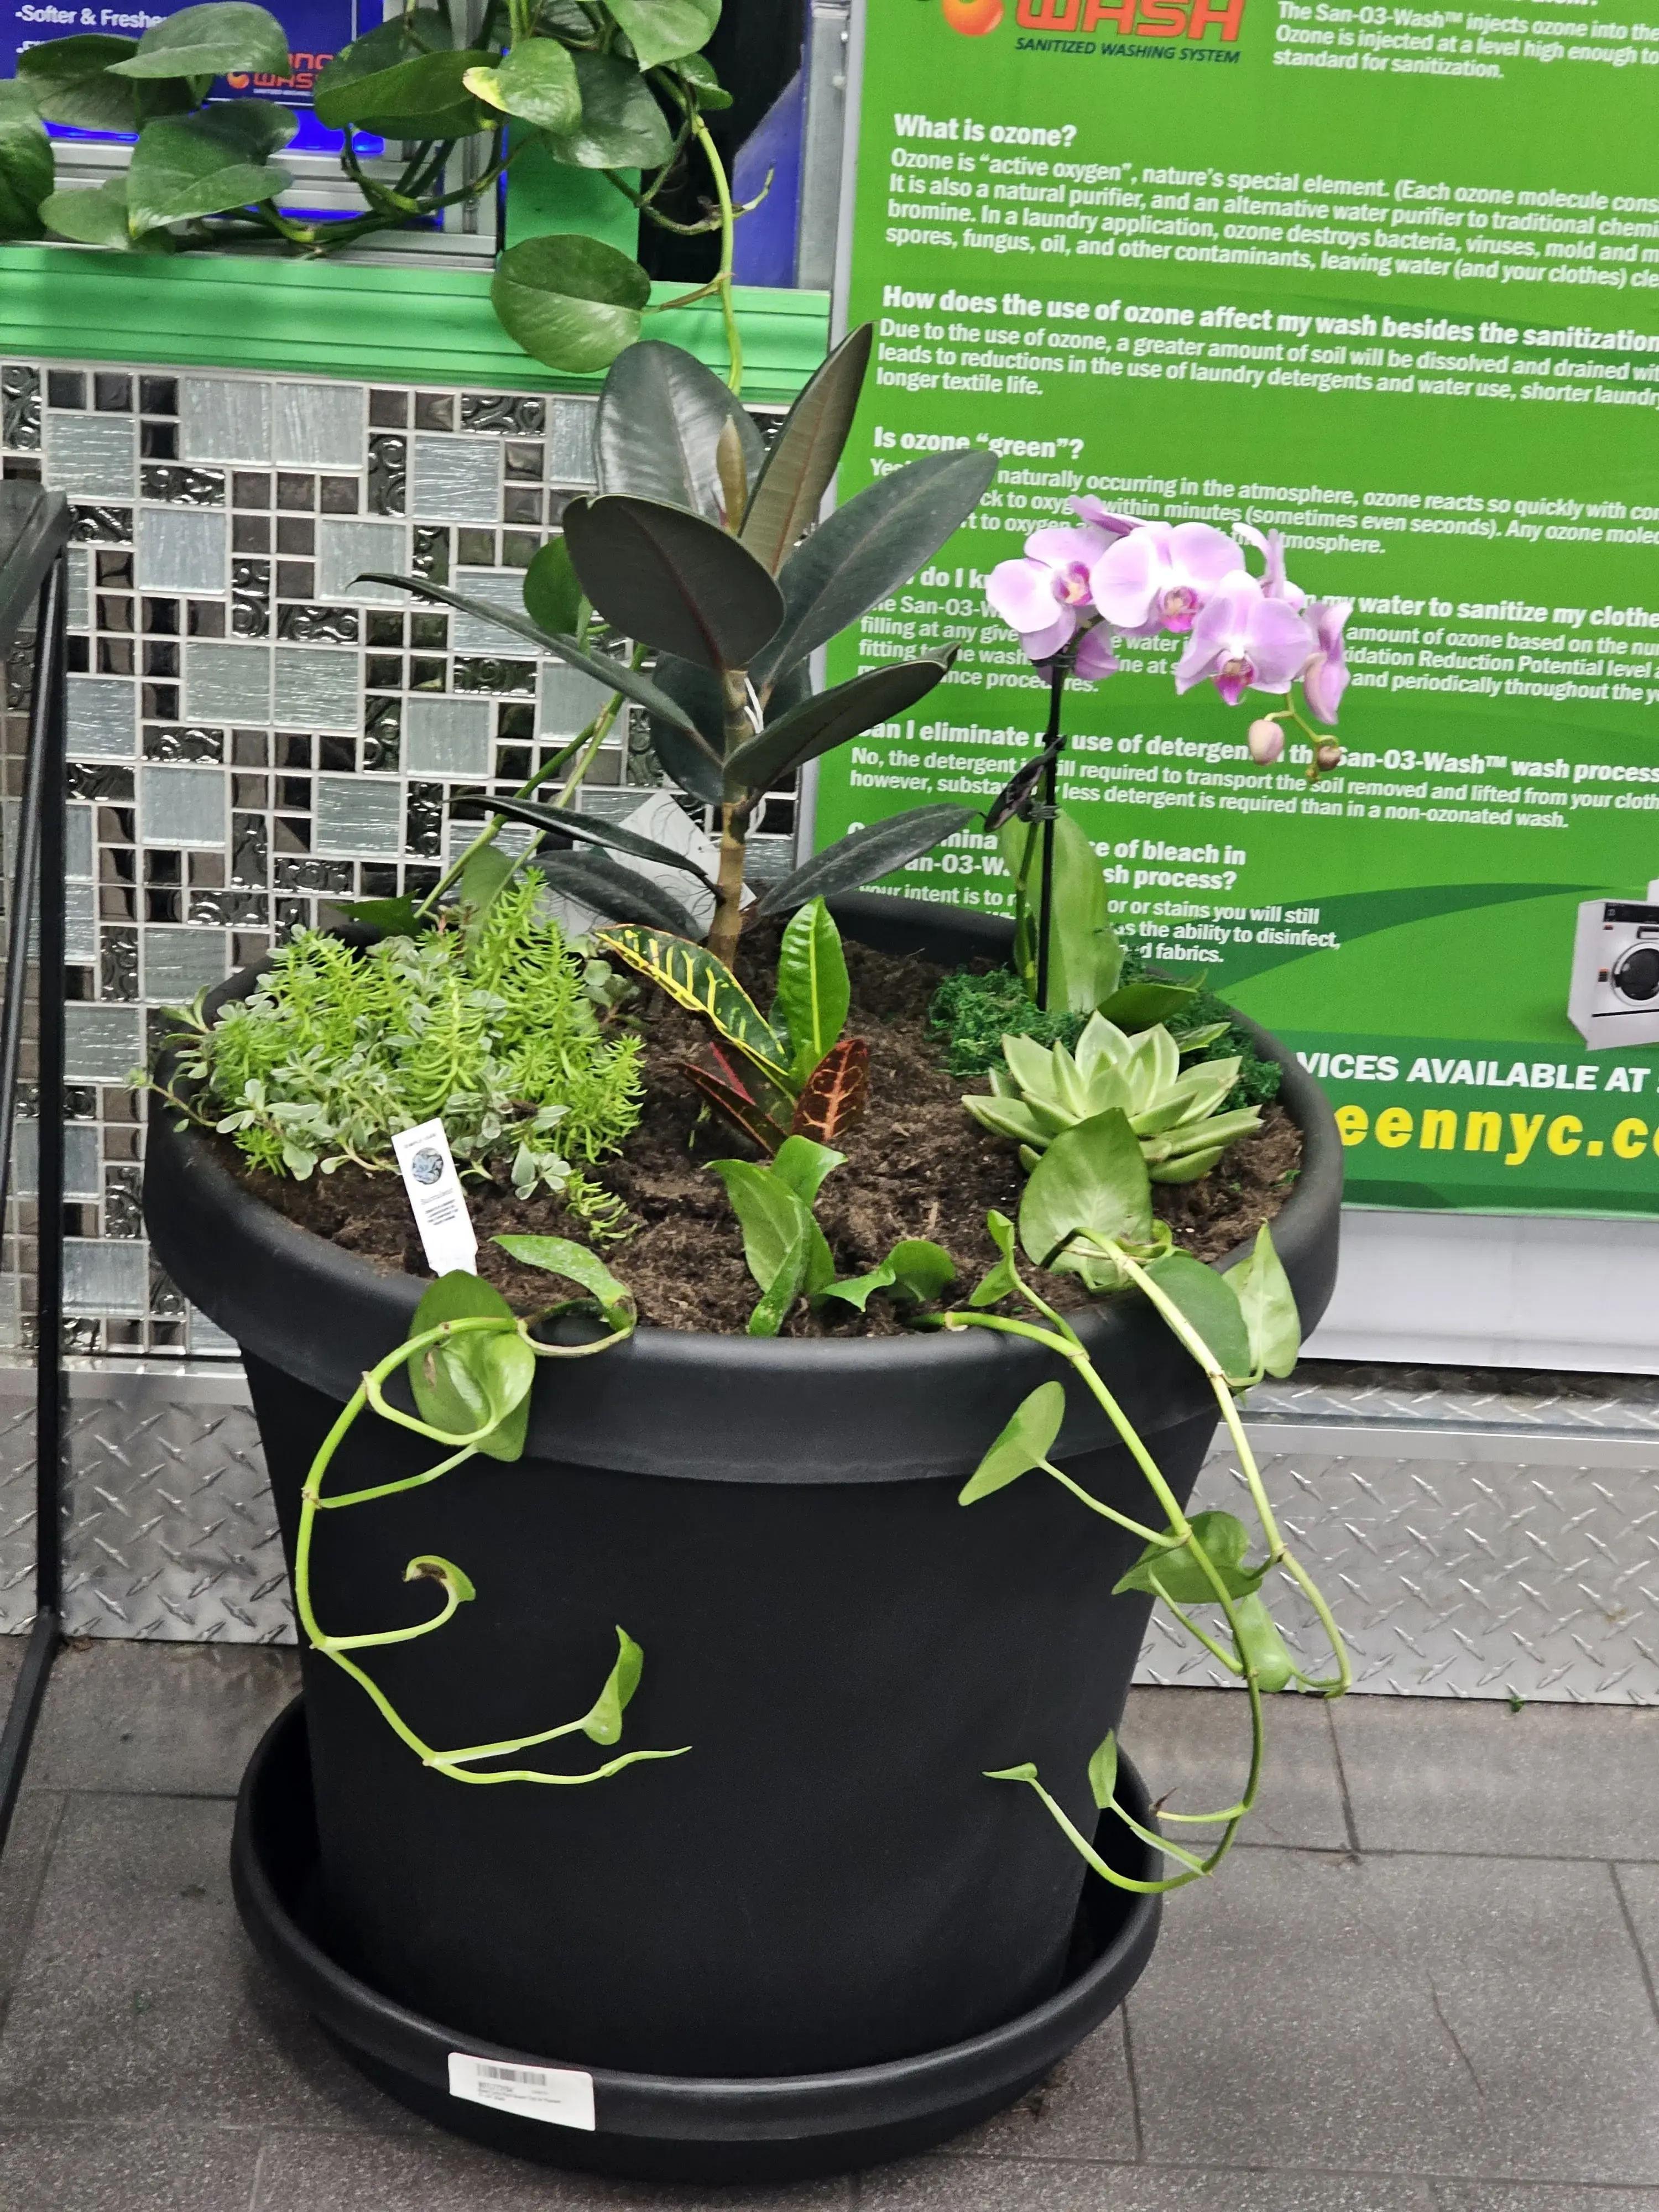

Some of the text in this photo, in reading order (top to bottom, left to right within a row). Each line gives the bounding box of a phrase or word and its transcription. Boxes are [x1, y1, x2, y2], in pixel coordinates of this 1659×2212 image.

[80, 8, 97, 25] &
[1015, 0, 1245, 42] WASH
[1277, 0, 1313, 22] The
[1465, 12, 1530, 36] injects
[1531, 19, 1589, 38] ozone
[1590, 19, 1629, 40] into
[1015, 37, 1240, 64] SANITIZED WASHING SYSTEM
[1275, 23, 1335, 46] Ozone
[1338, 27, 1355, 47] is
[1358, 28, 1434, 53] injected
[1437, 35, 1458, 53] at
[1459, 38, 1473, 55] a
[1476, 36, 1521, 57] level
[1524, 39, 1565, 63] high
[1567, 45, 1638, 68] enough
[1274, 48, 1503, 80] standard for sanitization.
[893, 112, 1077, 148] What is ozone?
[890, 147, 954, 171] Ozone
[957, 152, 976, 173] is
[1226, 171, 1300, 194] special
[1302, 174, 1390, 198] element.
[1393, 178, 1452, 202] (Each
[1453, 186, 1515, 205] ozone
[1516, 187, 1610, 211] molecule
[885, 227, 1628, 290] spores, fungus, oil, and other contaminants, leaving water (and your clothes)
[883, 284, 936, 310] How
[939, 289, 998, 315] does
[1001, 293, 1043, 318] the
[1046, 300, 1091, 320] use
[1094, 299, 1122, 322] of
[1123, 304, 1196, 327] ozone
[1198, 305, 1274, 332] affect
[1276, 314, 1313, 338] my
[1314, 313, 1378, 337] wash
[1381, 315, 1475, 343] besides
[1478, 321, 1520, 345] the
[877, 366, 1043, 396] longer textile life.
[873, 425, 897, 449] Is
[899, 431, 972, 451] ozone
[997, 468, 1627, 521] naturally occurring in the atmosphere, ozone reacts so quickly with
[1164, 500, 1604, 542] minutes (sometimes even seconds). Any ozone
[1358, 594, 1426, 617] water
[1428, 596, 1454, 618] to
[1457, 599, 1549, 623] sanitize
[1552, 607, 1587, 629] my
[1345, 626, 1629, 655] amount of ozone based on the
[1418, 649, 1652, 679] Reduction Potential level
[1351, 670, 1644, 702] and periodically throughout the
[906, 719, 1030, 747] I eliminate
[1071, 733, 1143, 754] use of
[851, 747, 1016, 778] No, the detergent
[1511, 758, 1571, 779] wash
[849, 769, 933, 794] however,
[1079, 763, 1614, 811] required to transport the soil removed and lifted from your
[1062, 782, 1569, 828] less detergent is required than in a non-ozonated wash.
[1114, 838, 1246, 866] of bleach in
[904, 884, 1004, 906] intent is to
[1133, 869, 1238, 891] process?
[1130, 900, 1320, 925] or stains you will still
[1139, 920, 1341, 951] the ability to disinfect,
[1155, 942, 1225, 963] fabrics.
[1406, 1058, 1600, 1091] AVAILABLE
[1604, 1067, 1651, 1093] AT
[1333, 1104, 1659, 1166] eennyc.c
